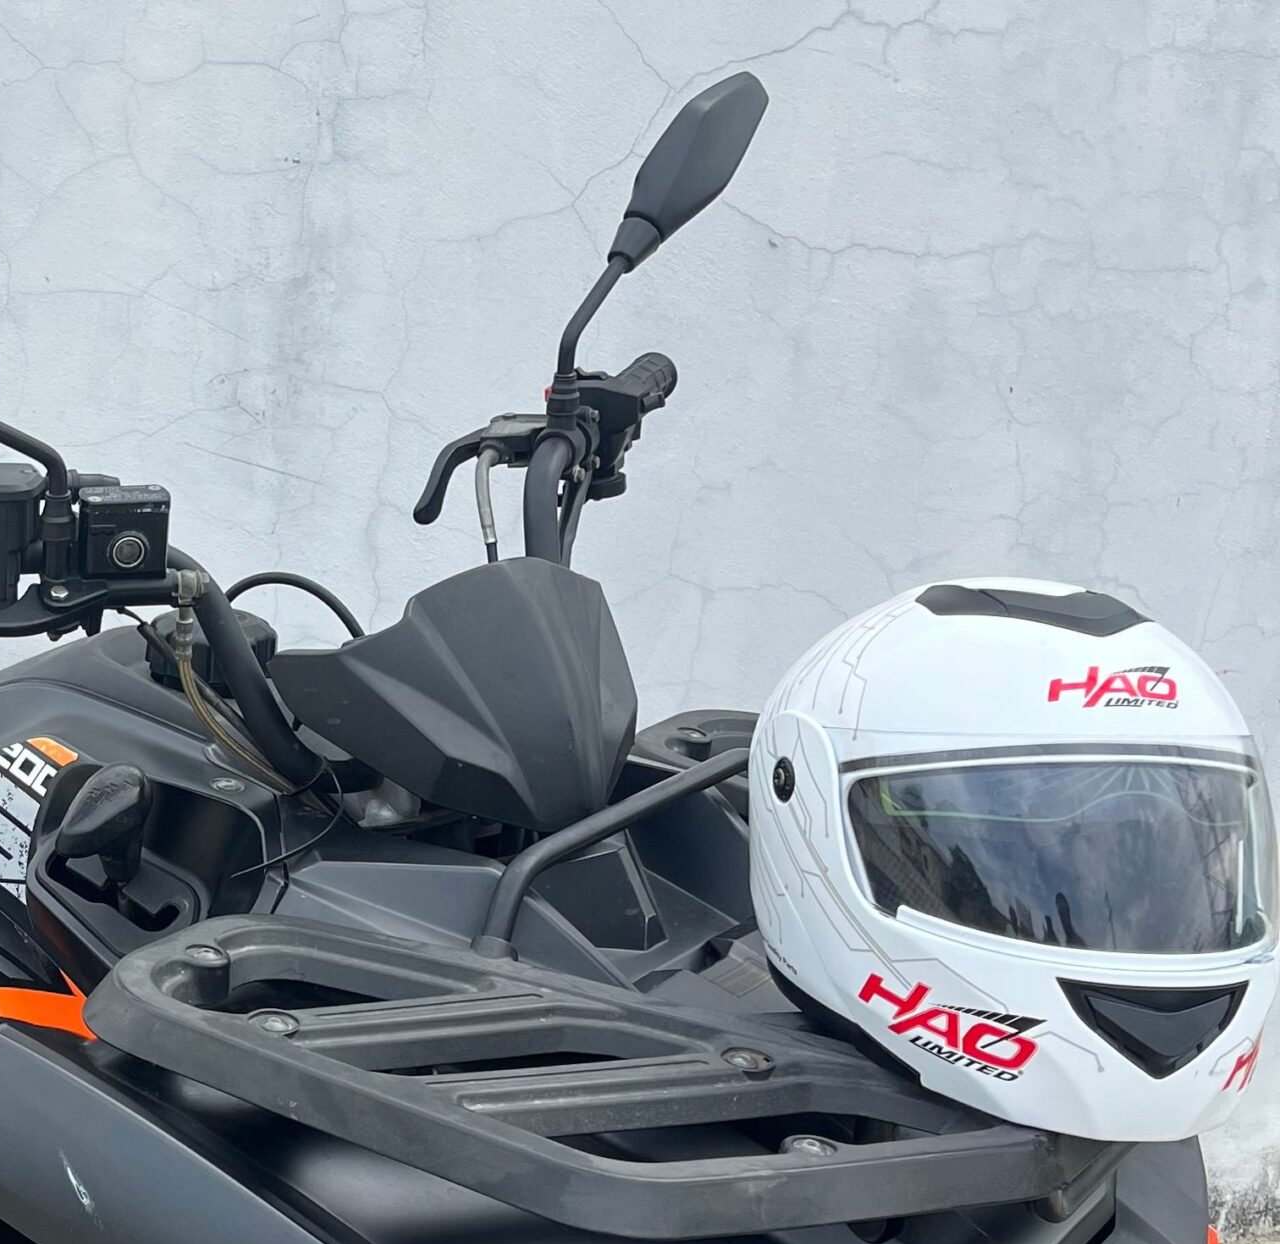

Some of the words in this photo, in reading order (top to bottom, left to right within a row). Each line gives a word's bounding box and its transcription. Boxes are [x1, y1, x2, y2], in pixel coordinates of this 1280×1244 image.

[1047, 665, 1178, 709] HAO
[1104, 697, 1179, 710] LIMITED
[857, 972, 1039, 1071] HAO
[908, 1035, 1020, 1082] LIMITED
